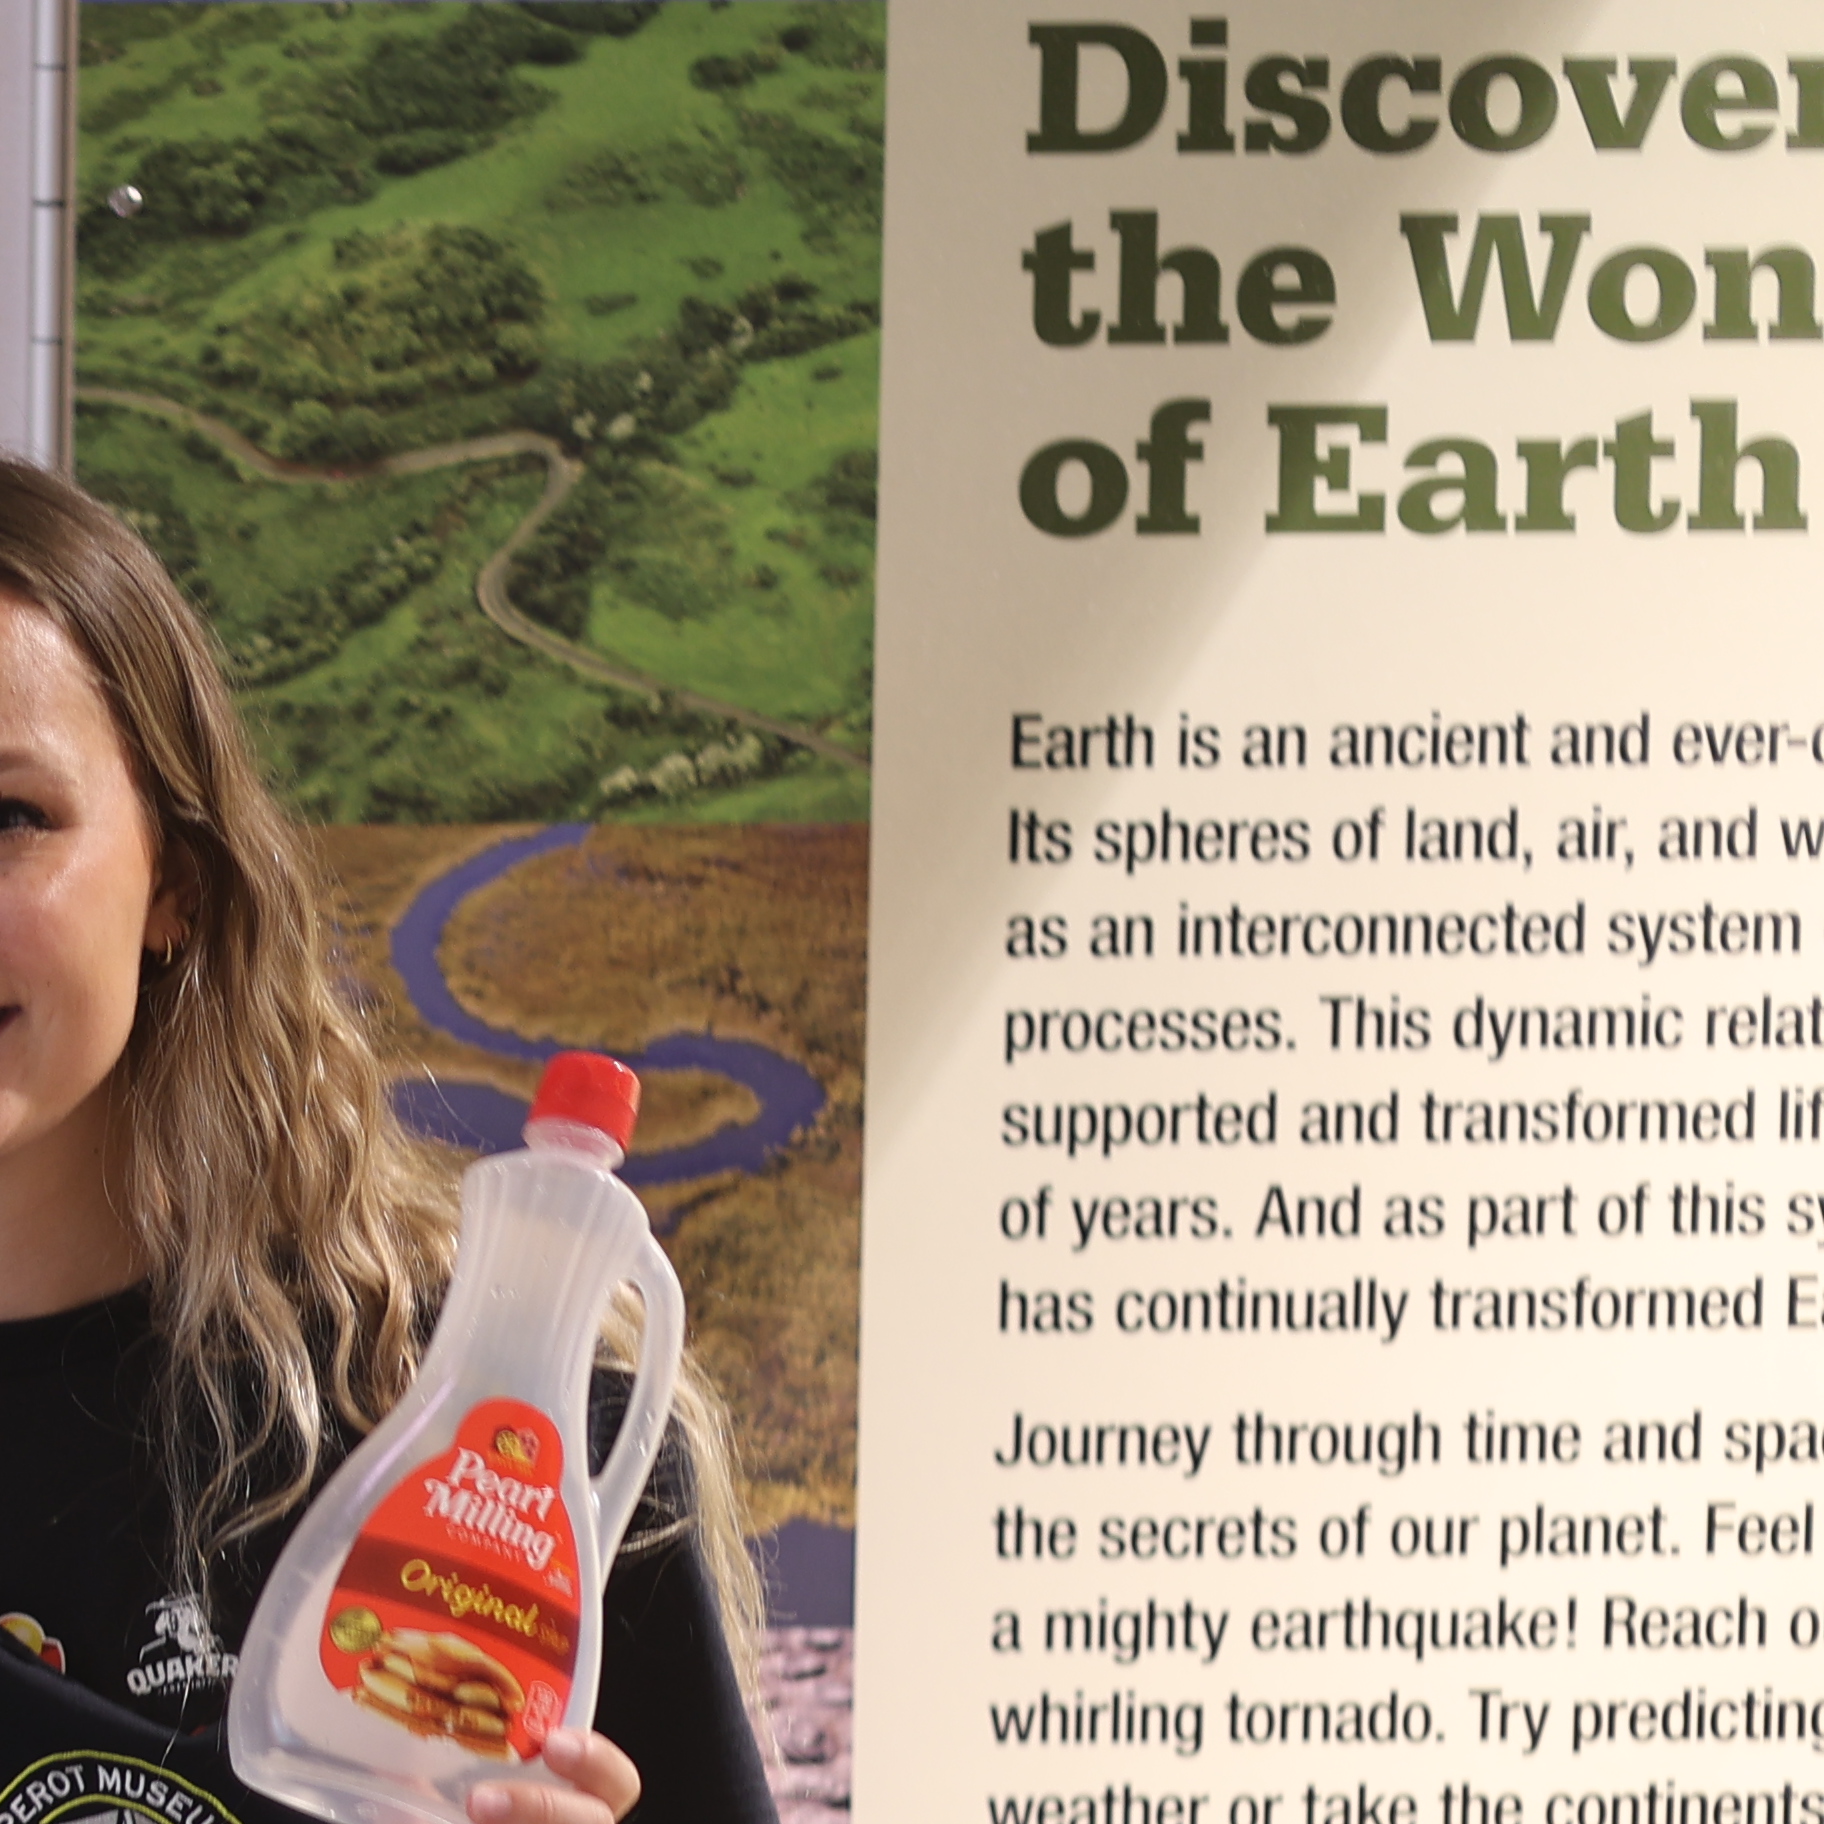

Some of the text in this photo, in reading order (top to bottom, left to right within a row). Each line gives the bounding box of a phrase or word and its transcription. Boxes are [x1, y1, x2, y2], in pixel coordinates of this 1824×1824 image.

[1022, 210, 1824, 349] the Won
[1019, 398, 1808, 540] of Earth
[1011, 714, 1154, 769] Earth
[1179, 714, 1220, 768] is
[1242, 726, 1306, 767] an
[1330, 712, 1528, 767] ancient
[1551, 712, 1649, 765] and
[1005, 902, 1801, 965] as an interconnected system
[446, 1447, 556, 1524] Pearl
[422, 1477, 556, 1572] Milling
[994, 1503, 1813, 1568] the secrets of our planet. Feel
[400, 1558, 540, 1638] Original
[126, 1652, 240, 1698] QUAKER
